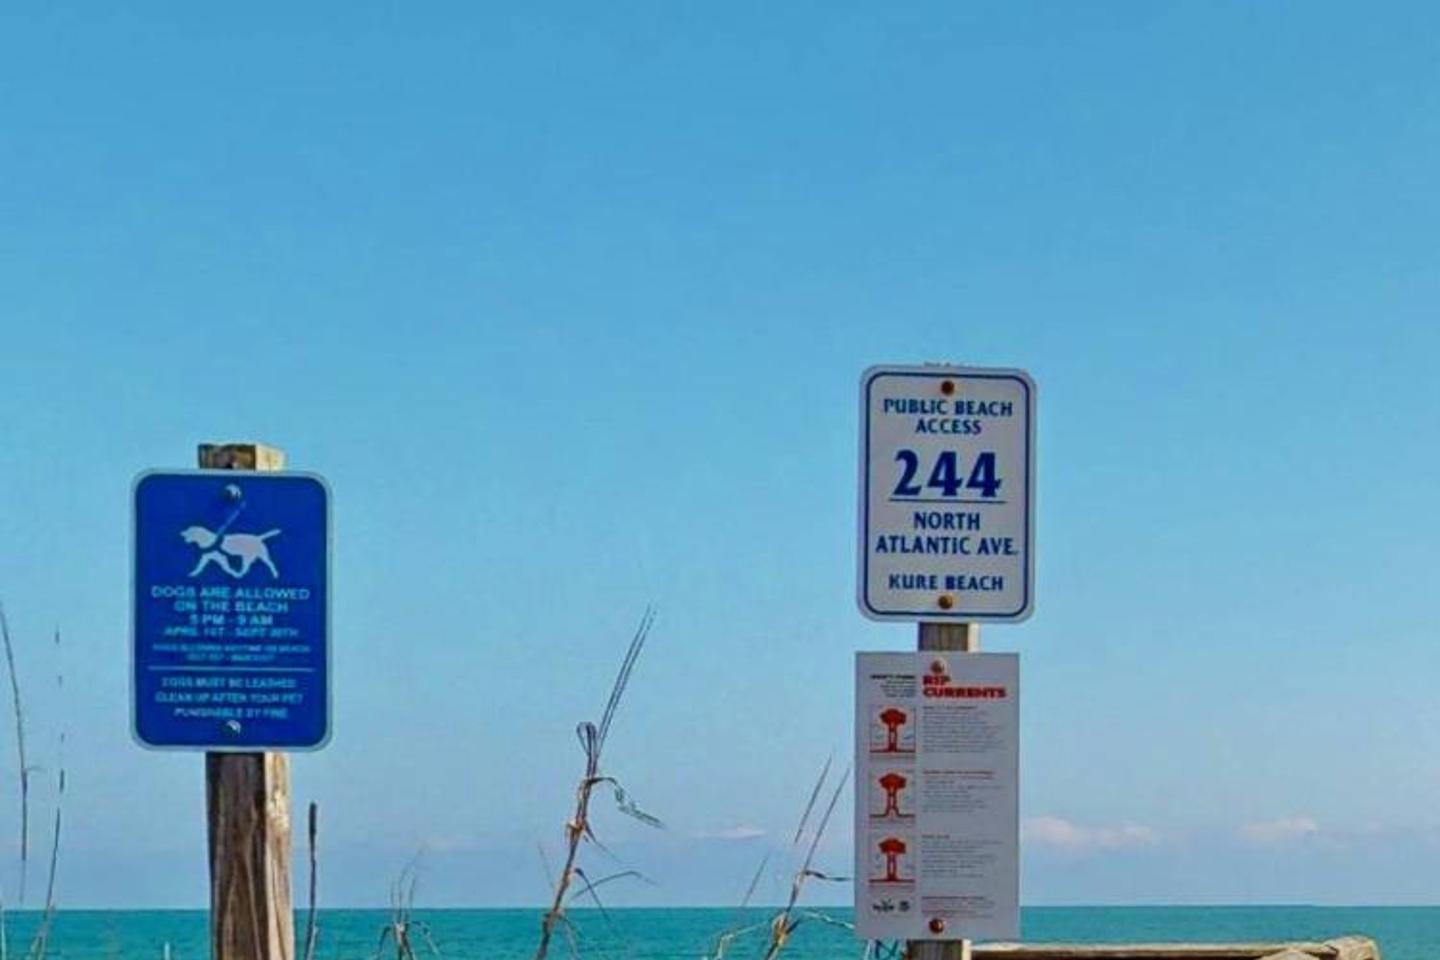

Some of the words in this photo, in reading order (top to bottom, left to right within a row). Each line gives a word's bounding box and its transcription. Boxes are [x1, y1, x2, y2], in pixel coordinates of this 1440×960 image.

[884, 399, 947, 415] PUBLIC
[955, 401, 1013, 417] BEACH
[915, 419, 981, 435] ACCESS
[893, 449, 1002, 498] 244
[913, 512, 980, 531] NORTH
[876, 536, 970, 555] ATLANTIC
[977, 538, 1018, 555] AVE.
[888, 575, 938, 590] KURE
[945, 575, 1004, 590] BEACH
[151, 586, 196, 598] DOGS
[200, 586, 230, 599] ARE
[234, 587, 310, 600] ALLOWED
[174, 600, 196, 612] ON
[203, 600, 230, 612] THE
[235, 601, 288, 613] BEACH
[202, 614, 225, 625] PM
[250, 615, 273, 625] AM
[922, 675, 951, 686] RIP
[922, 687, 1007, 698] CURRENTS
